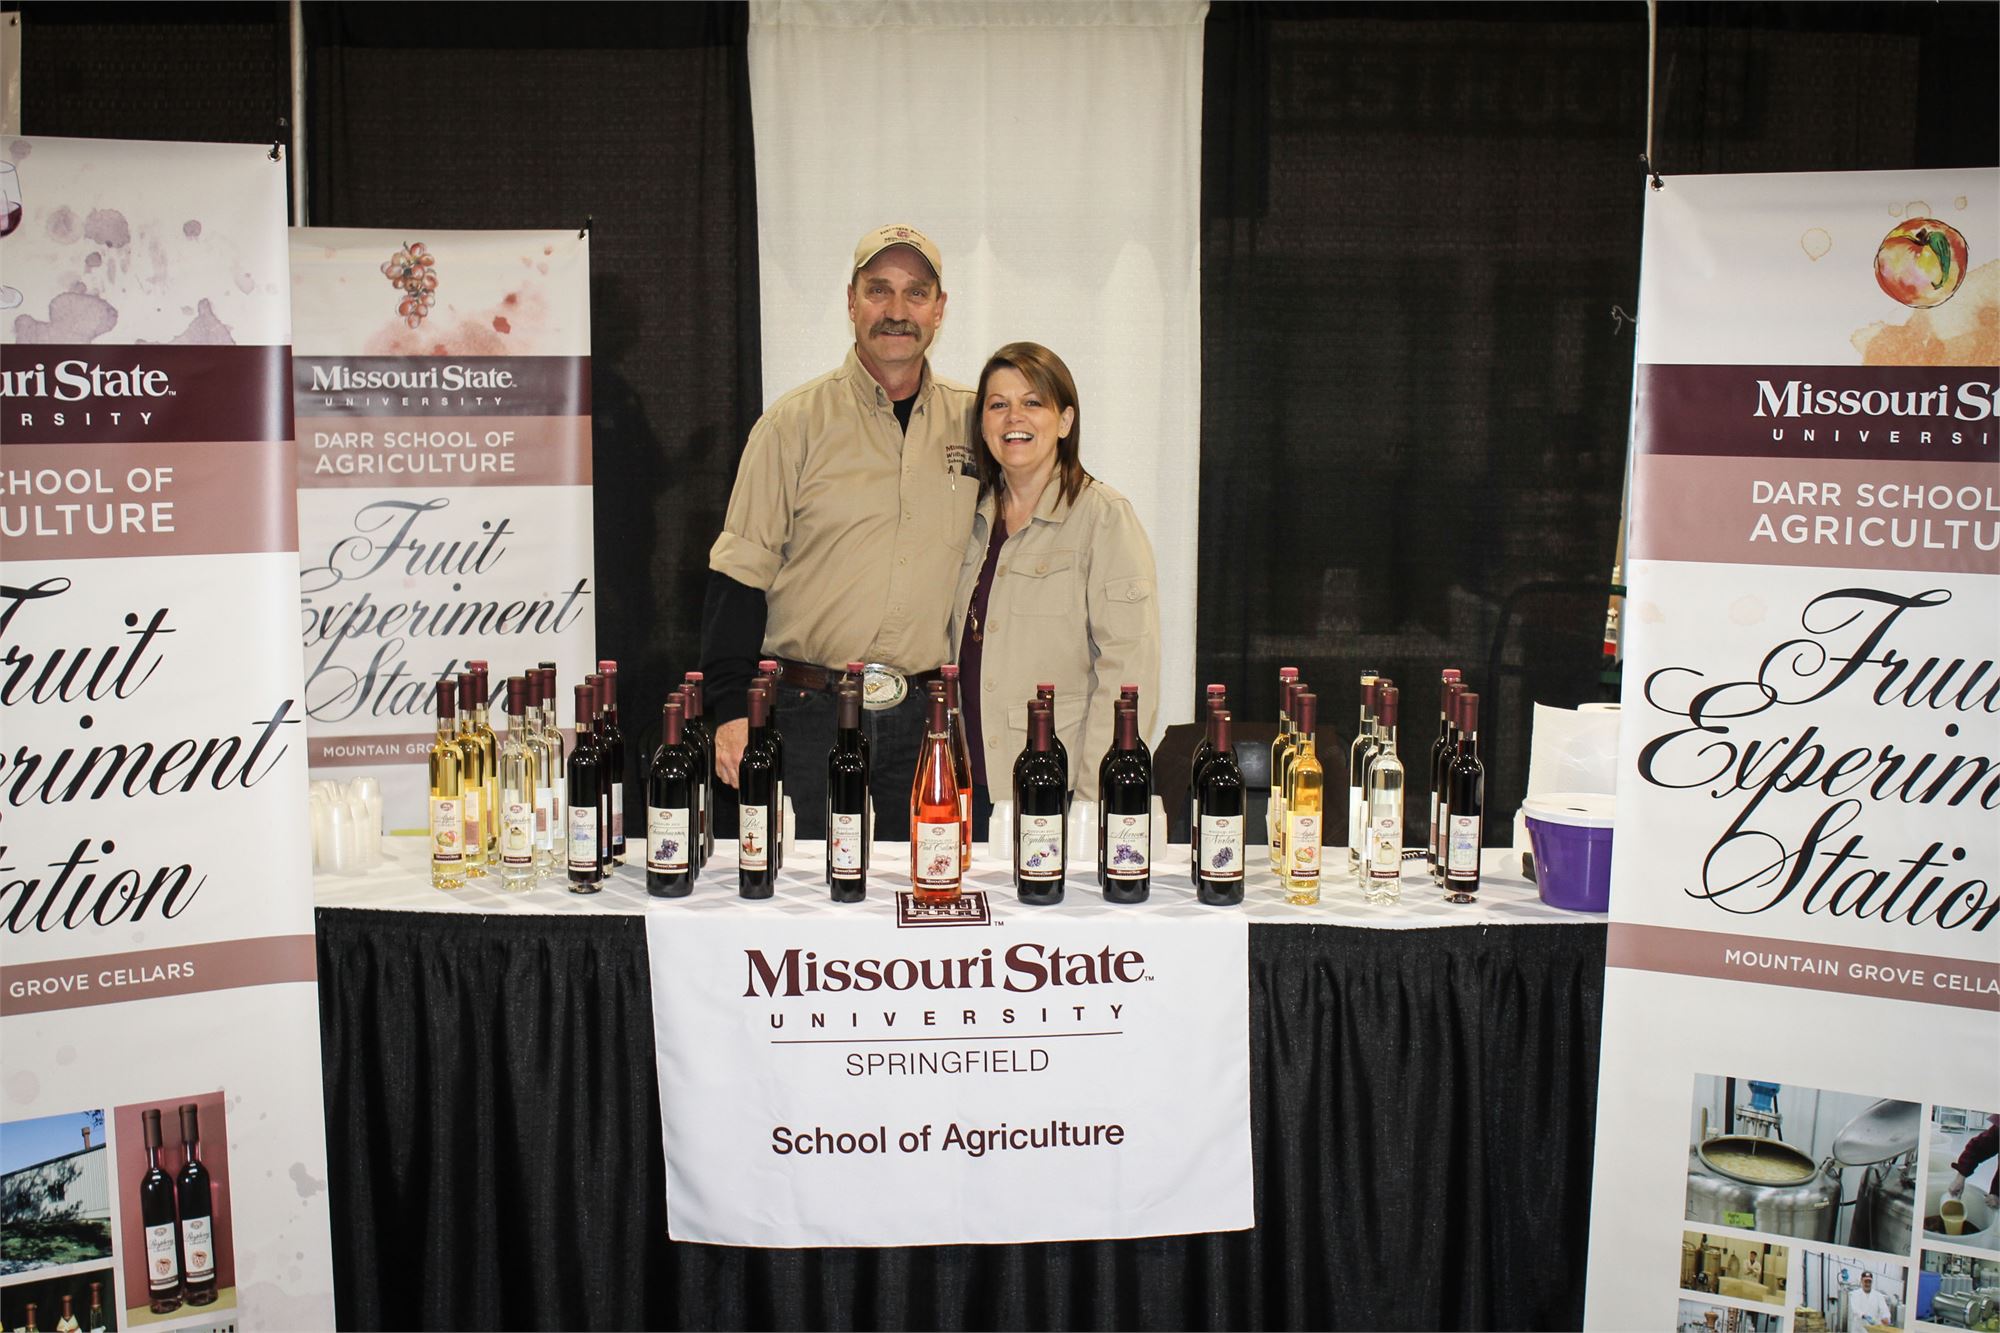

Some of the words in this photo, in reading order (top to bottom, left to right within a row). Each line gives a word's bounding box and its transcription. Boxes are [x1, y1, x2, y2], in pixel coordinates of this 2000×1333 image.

[54, 360, 168, 401] State
[311, 365, 438, 391] Missouri
[442, 364, 513, 391] State
[325, 396, 502, 407] UNIVERSITY
[1753, 380, 1948, 418] Missouri
[315, 432, 374, 449] DARR
[384, 431, 477, 449] SCHOOL
[485, 431, 515, 448] OF
[127, 467, 173, 493] OF
[315, 452, 516, 474] AGRICULTURE
[1752, 480, 1842, 506] DARR
[1856, 483, 2000, 511] SCHOOL
[328, 497, 514, 581] Fruit
[0, 699, 301, 807] riment
[324, 743, 400, 757] MOUNTAIN
[406, 742, 437, 755] GRO
[0, 838, 207, 935] ation
[10, 973, 89, 998] GROVE
[99, 961, 195, 988] CELLARS
[742, 948, 994, 998] Missouri
[1003, 943, 1145, 993] State
[1725, 949, 1839, 977] MOUNTAIN
[1848, 962, 1925, 987] GROVE
[771, 1004, 1123, 1029] UNIVERSITY
[846, 1049, 1050, 1077] SPRINGFIELD
[772, 1127, 887, 1155] School
[899, 1125, 932, 1153] of
[941, 1121, 1125, 1158] Agriculture
